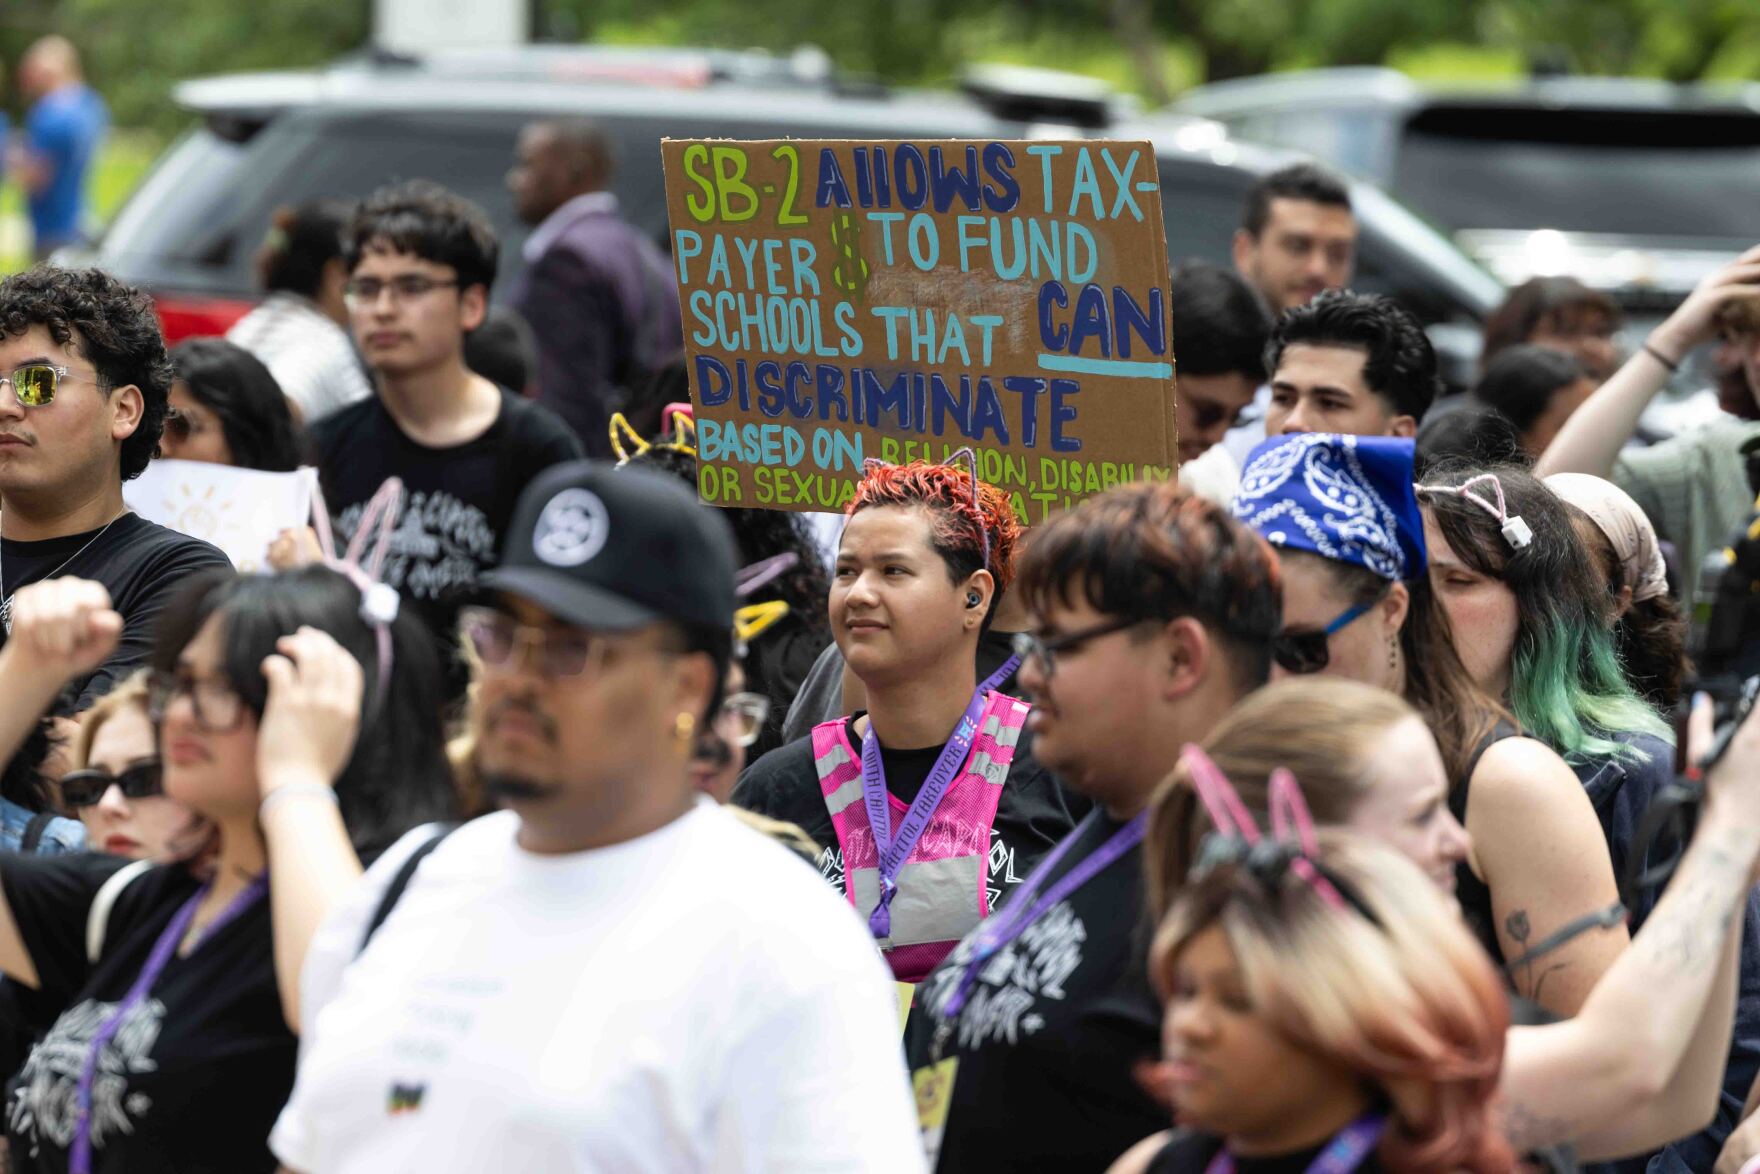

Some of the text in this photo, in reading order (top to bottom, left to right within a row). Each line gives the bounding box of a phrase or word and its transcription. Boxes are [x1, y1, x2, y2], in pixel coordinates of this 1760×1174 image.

[684, 144, 809, 225] SB-2
[1026, 145, 1158, 222] TAX-
[675, 230, 821, 296] PAYER
[866, 212, 940, 271] TO
[957, 215, 1098, 284] FUND
[690, 280, 1166, 366] SCHOOLS THAT CAN
[695, 355, 1082, 451] DISCRIMINATE
[697, 418, 806, 468] BASED
[812, 427, 867, 473] ON
[700, 464, 858, 508] OR SEXUA
[913, 745, 964, 821] TAKEOVER
